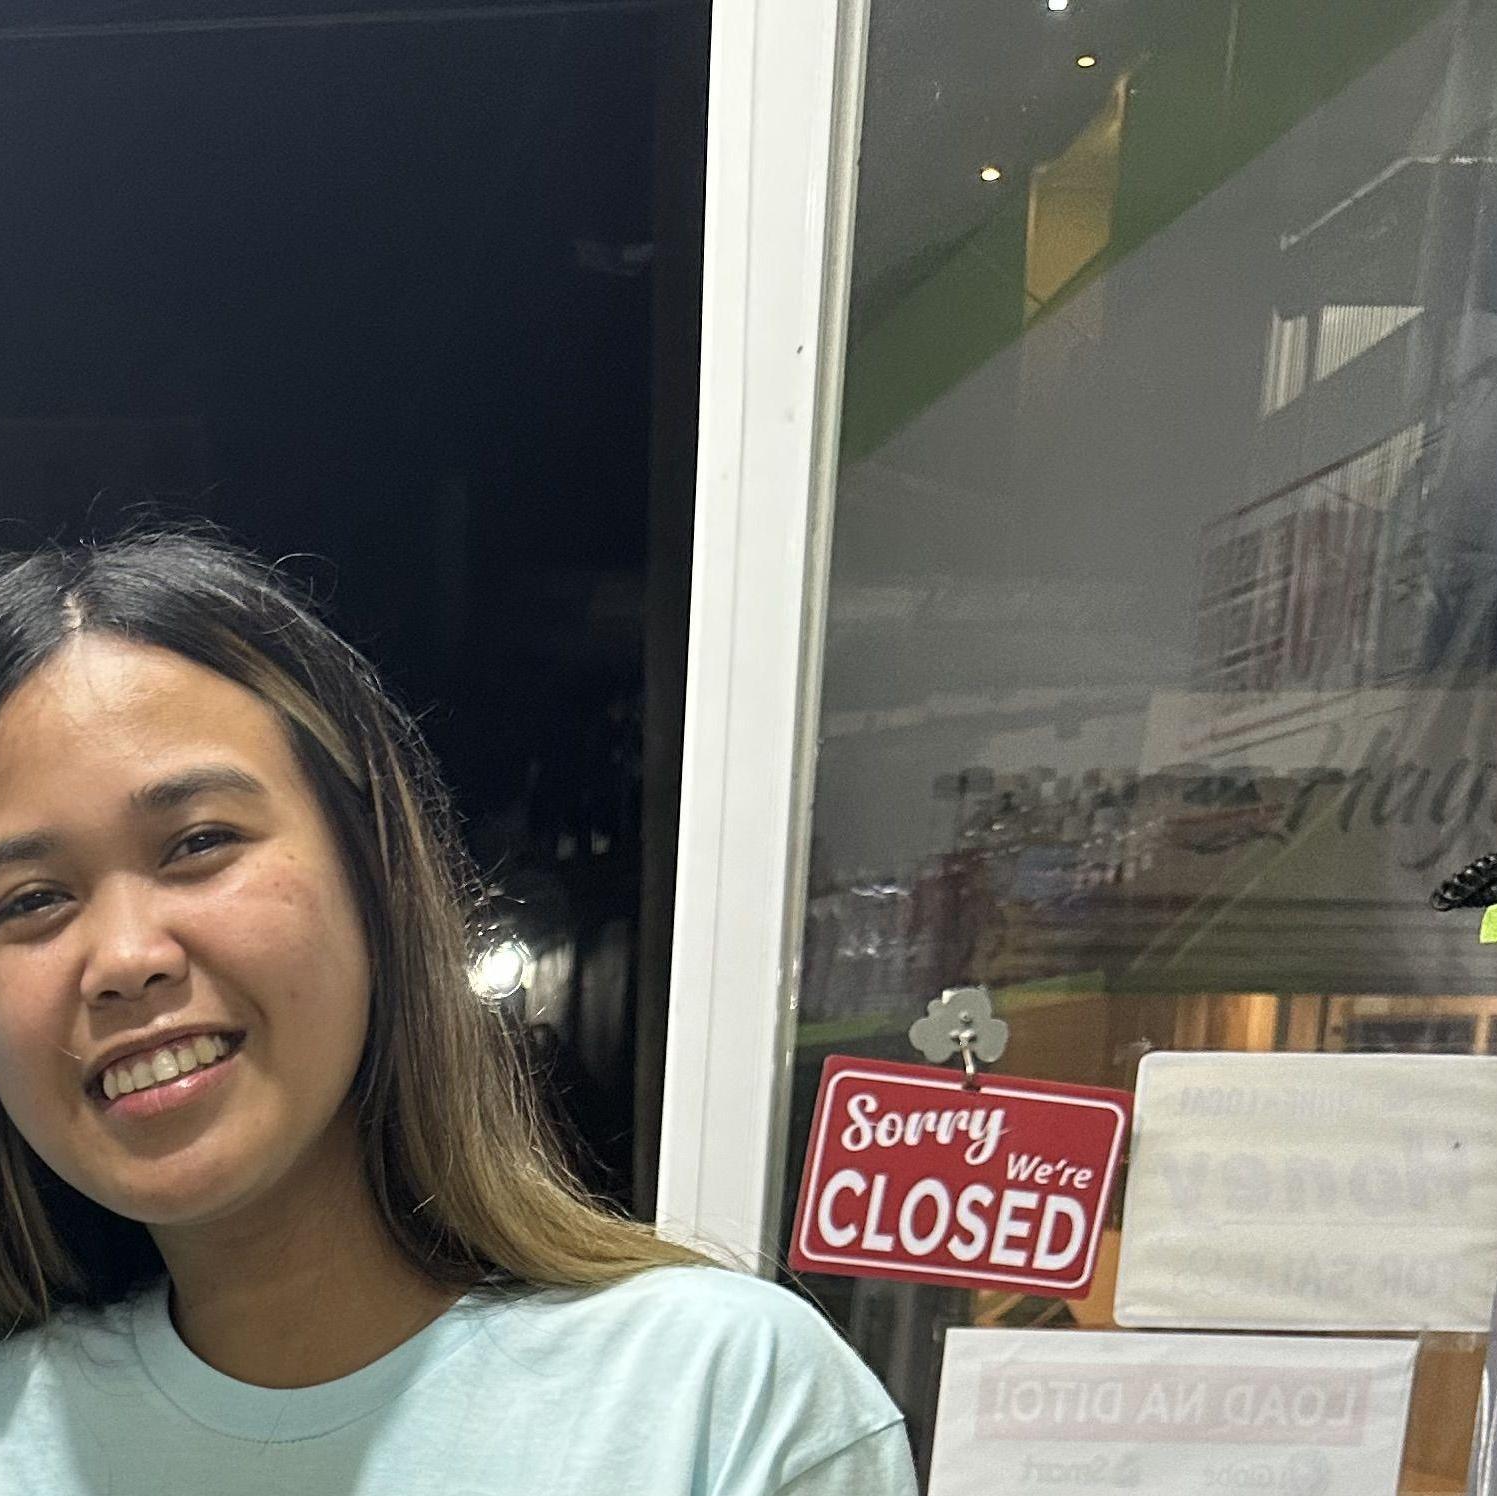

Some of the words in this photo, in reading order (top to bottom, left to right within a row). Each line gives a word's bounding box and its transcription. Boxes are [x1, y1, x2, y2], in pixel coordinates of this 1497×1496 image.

[841, 1093, 1008, 1166] Sorry
[1006, 1152, 1093, 1189] We're
[817, 1168, 1087, 1272] CLOSED
